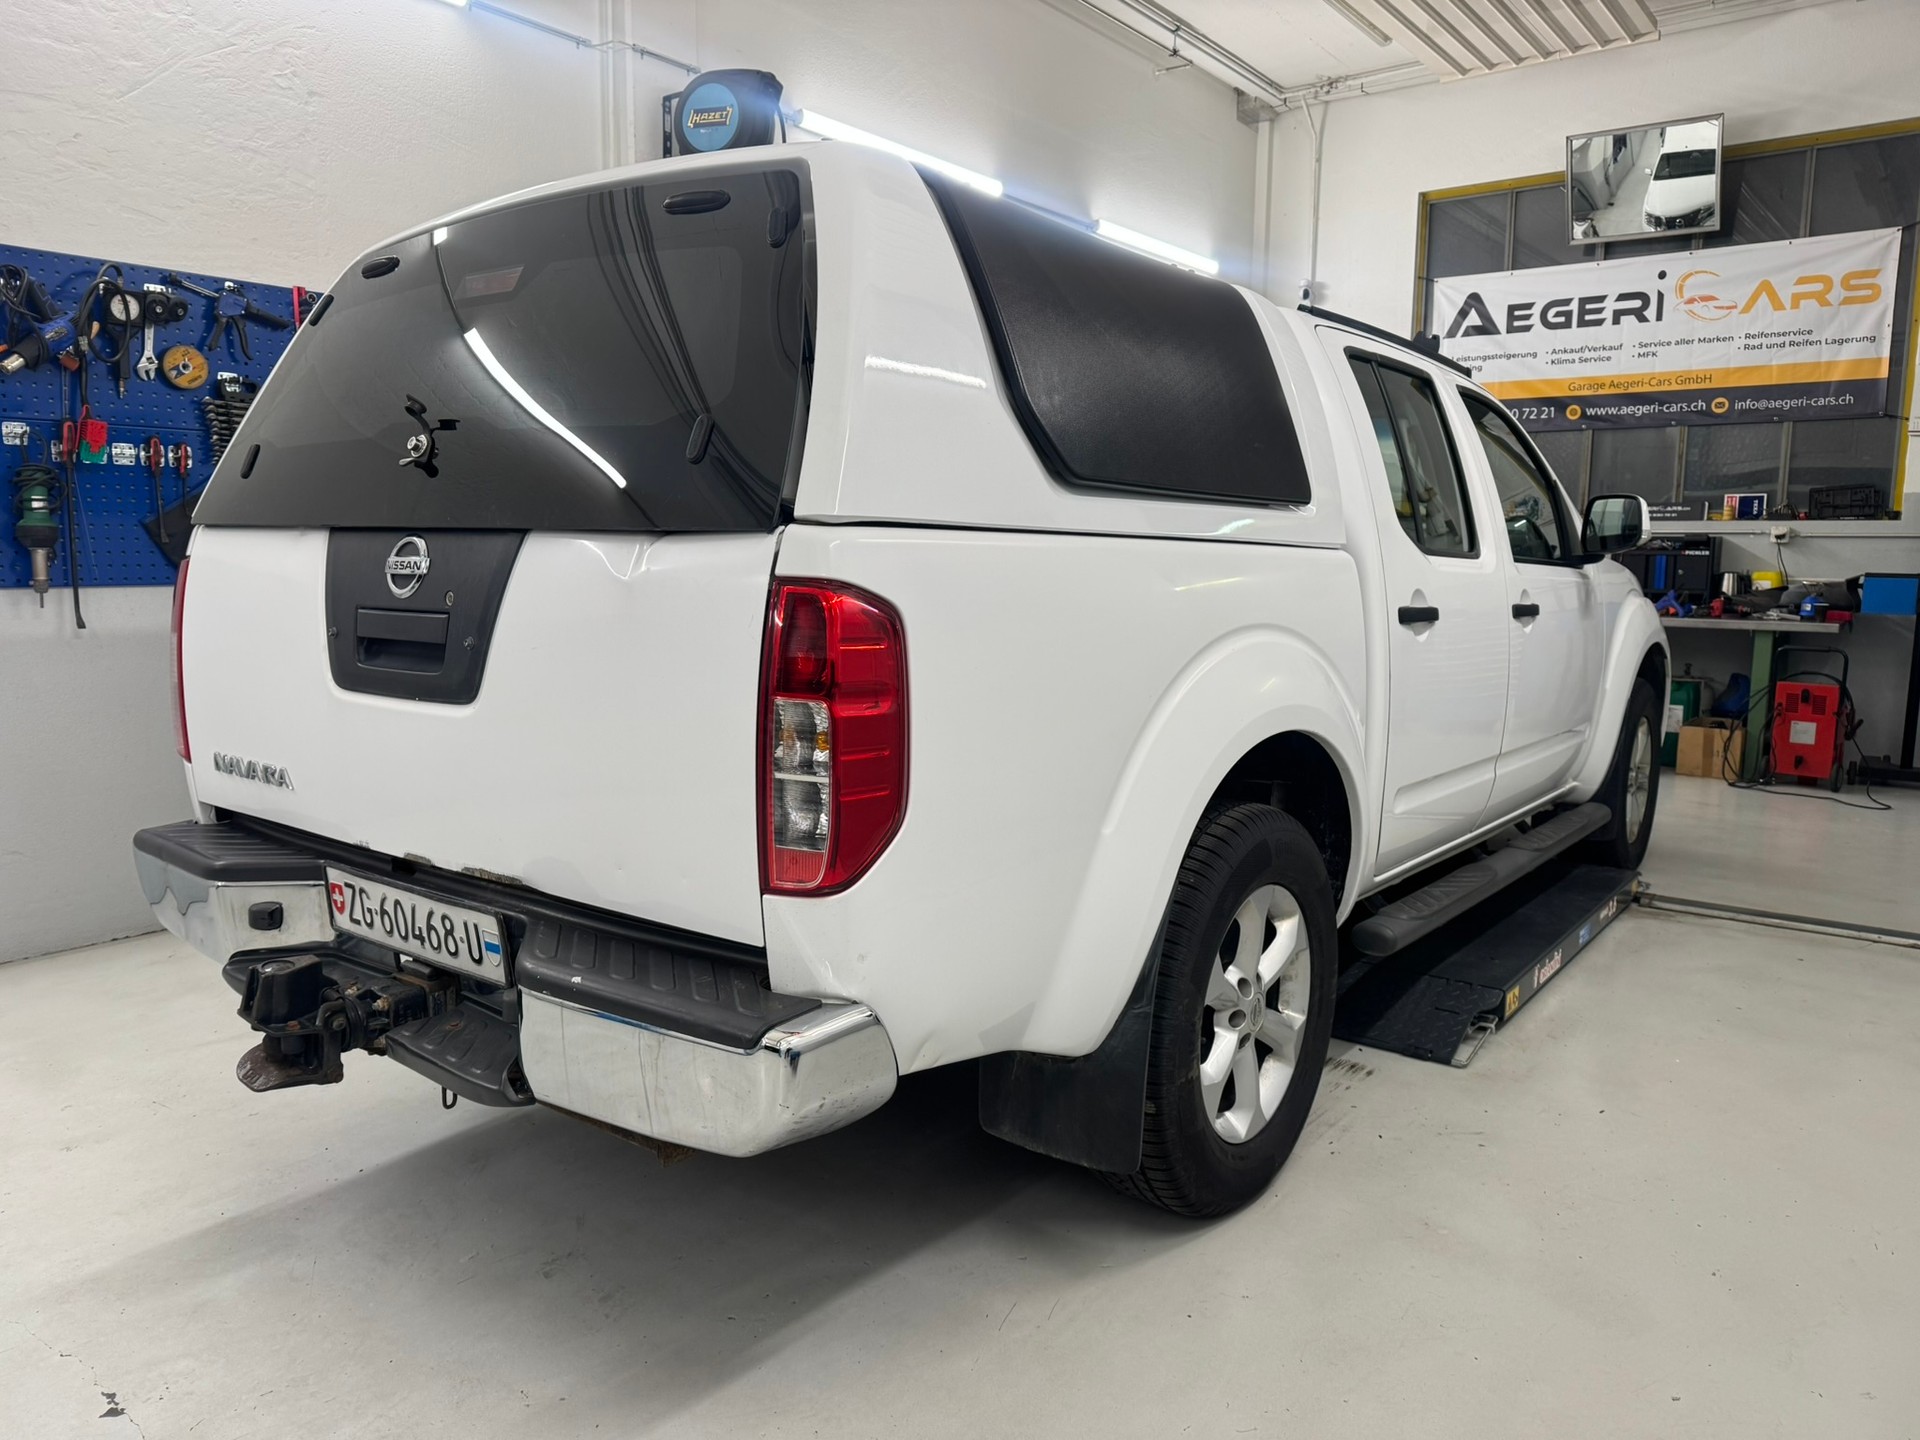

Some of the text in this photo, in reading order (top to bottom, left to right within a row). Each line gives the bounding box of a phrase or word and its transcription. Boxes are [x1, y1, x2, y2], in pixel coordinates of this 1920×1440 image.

[691, 111, 728, 124] HAZET
[1744, 328, 1814, 340] Reifenservice
[1638, 335, 1735, 349] Service aller Marken
[1743, 334, 1877, 351] Rad und Reifen Lagerung
[1550, 343, 1624, 356] Ankauf/Verkauf
[1637, 351, 1658, 359] MFK
[1550, 354, 1612, 366] Klima Service
[1568, 374, 1713, 394] Garage Aegeri-Cars GmbH
[1585, 399, 1706, 417] www.aegeri-cars.ch
[1734, 393, 1854, 411] info@aegeri-cars.ch
[1522, 407, 1538, 420] 72
[1540, 406, 1555, 419] 21
[387, 560, 422, 571] NISSAN
[213, 751, 295, 791] NAVARA
